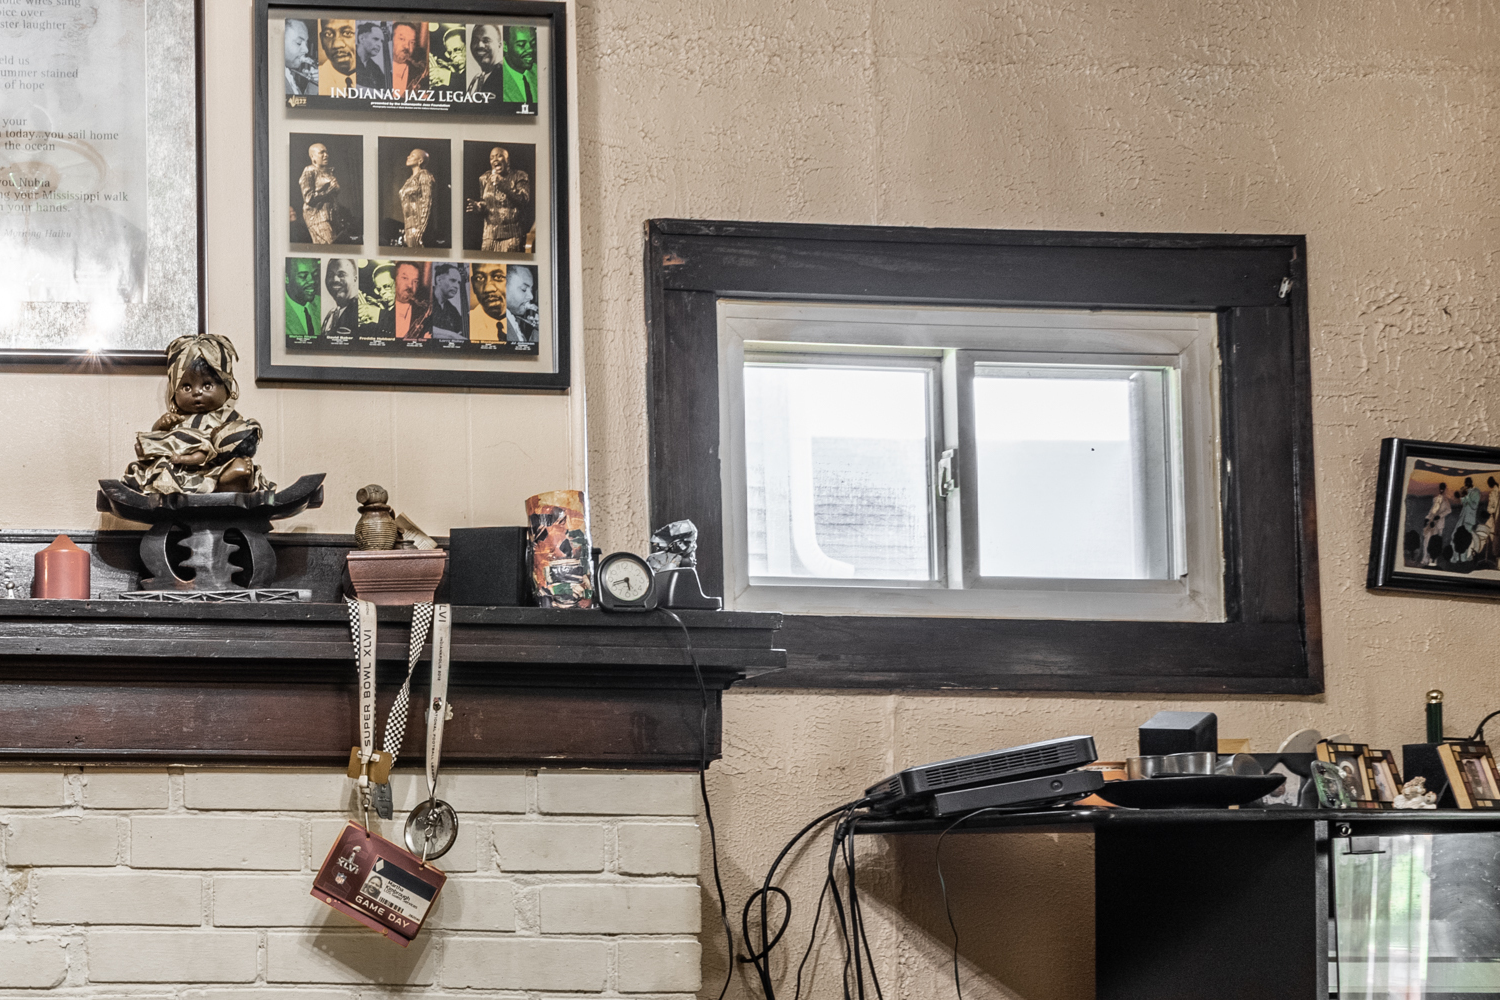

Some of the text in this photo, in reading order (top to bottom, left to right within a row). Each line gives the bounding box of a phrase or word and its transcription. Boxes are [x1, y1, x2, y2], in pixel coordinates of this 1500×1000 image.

[20, 9, 45, 17] over
[22, 20, 66, 31] laughter
[18, 58, 30, 66] us
[41, 68, 79, 78] stained
[4, 80, 17, 89] of
[19, 80, 45, 92] hope
[330, 87, 492, 105] INDIANA'S JAZZ LEGACY
[2, 118, 27, 128] your
[67, 130, 86, 140] sail
[90, 130, 119, 140] home
[4, 140, 21, 150] the
[24, 143, 56, 151] ocean
[19, 177, 50, 187] Nubia
[14, 191, 38, 201] your
[42, 190, 100, 203] Mississippi
[103, 191, 129, 202] walk
[7, 204, 32, 214] your
[36, 202, 70, 213] hands.
[438, 605, 448, 623] LVI
[362, 629, 372, 747] SUPER BOWL XLVI
[337, 860, 361, 875] XLVI
[355, 895, 385, 916] GAME
[387, 912, 411, 929] DAY
